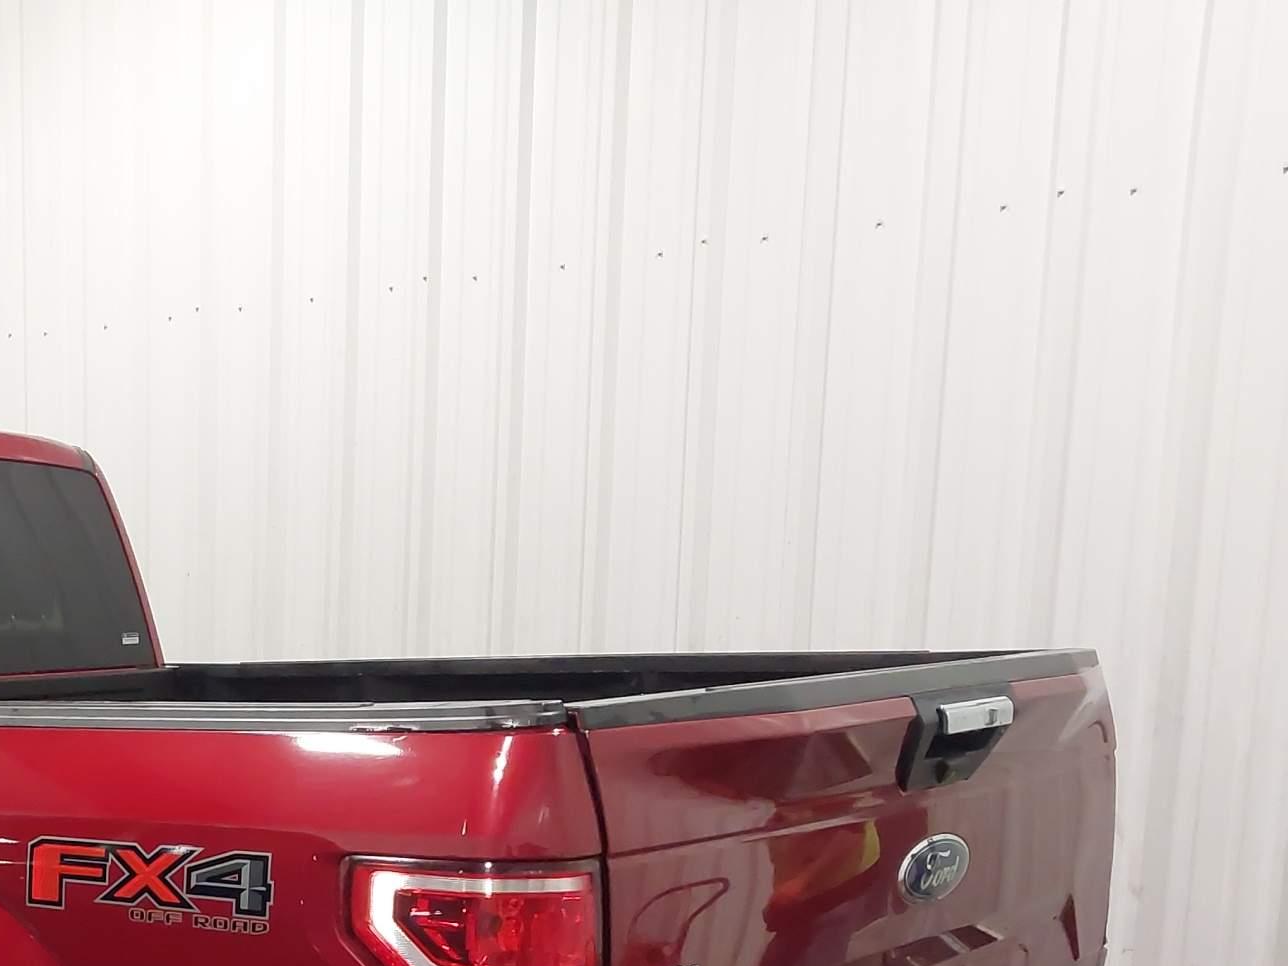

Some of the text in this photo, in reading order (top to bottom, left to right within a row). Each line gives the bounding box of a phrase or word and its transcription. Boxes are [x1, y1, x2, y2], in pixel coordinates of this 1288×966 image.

[26, 835, 274, 920] FX4
[920, 849, 960, 890] Ford
[128, 908, 270, 935] OFF ROAD
